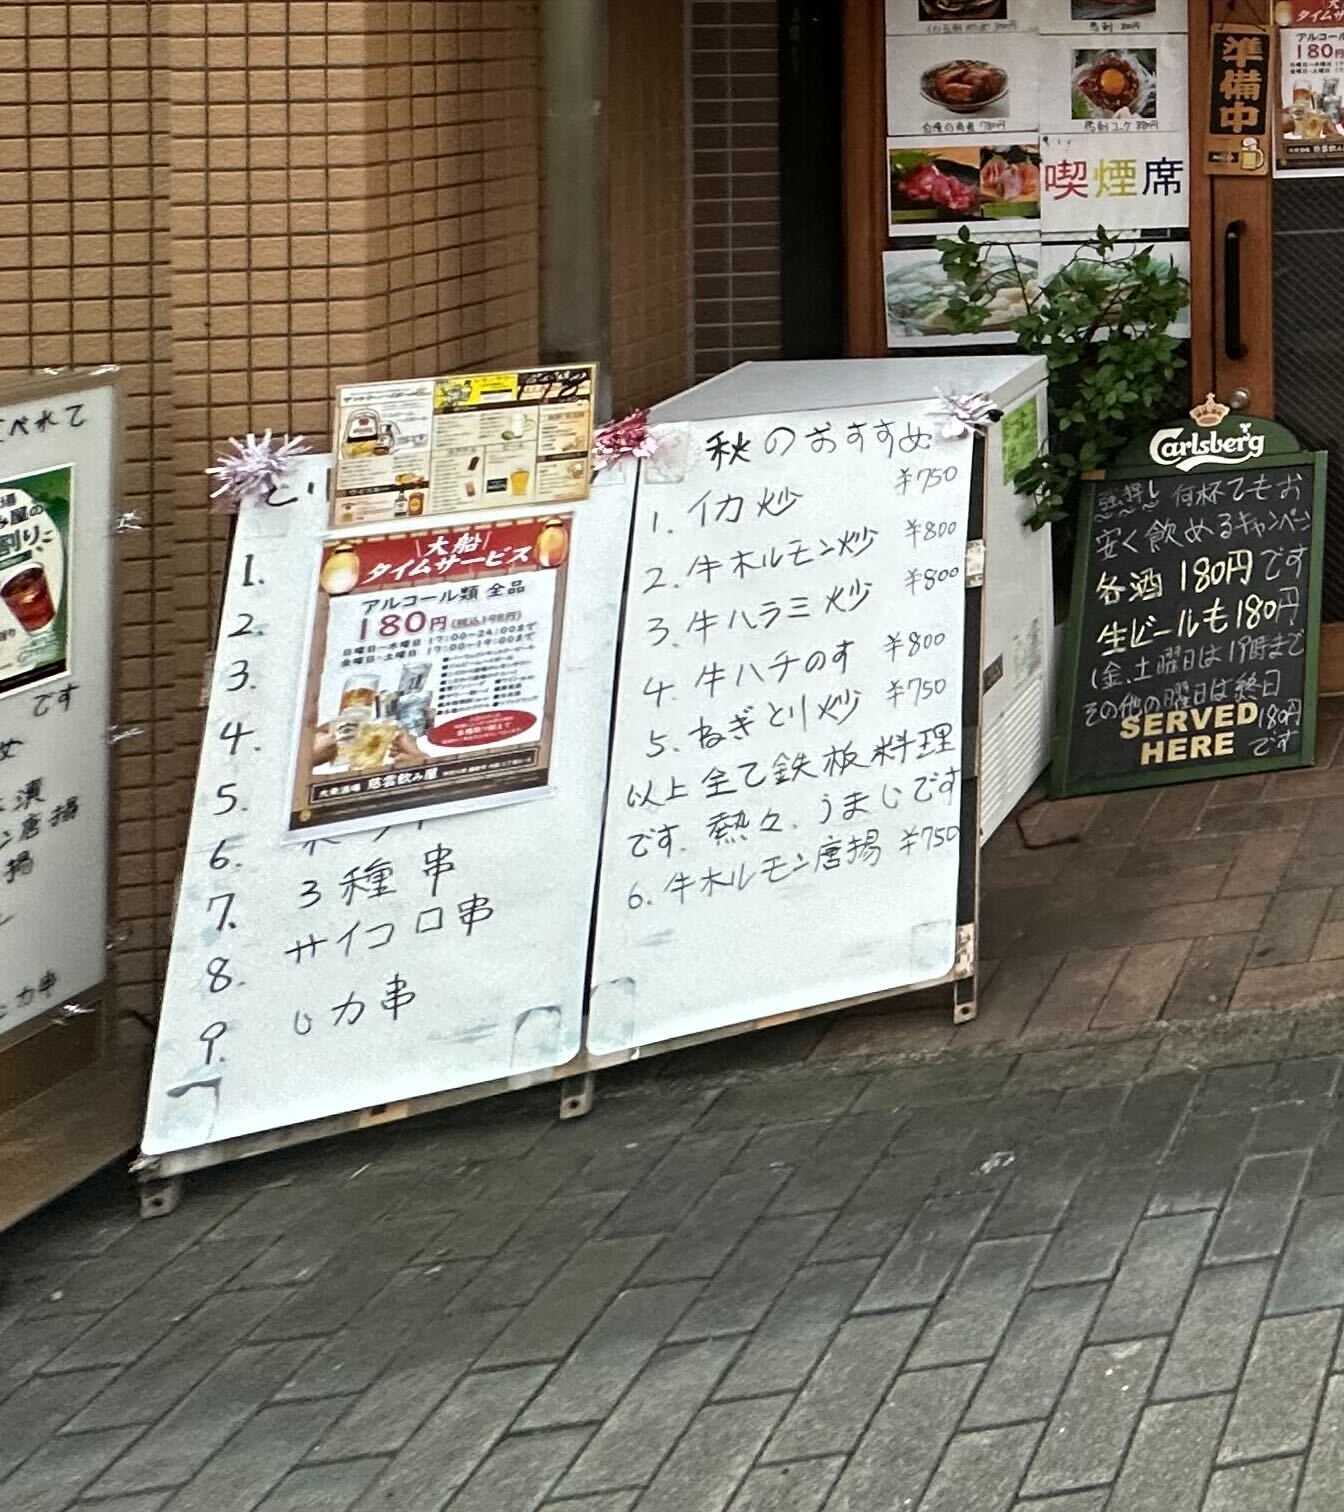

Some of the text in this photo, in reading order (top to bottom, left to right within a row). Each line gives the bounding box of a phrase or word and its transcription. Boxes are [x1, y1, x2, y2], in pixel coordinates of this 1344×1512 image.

[1220, 37, 1262, 134] 準備中
[1045, 156, 1184, 200] 喫煙席
[706, 419, 934, 471] 秋のおすすめ
[1150, 423, 1265, 466] Carlsberg
[688, 486, 803, 527] イカ炒
[895, 466, 957, 495] ¥750
[425, 532, 482, 556] 大船
[905, 519, 957, 549] ¥800
[361, 545, 533, 584] タイムサービス
[1096, 545, 1308, 606] 各酒 180円です
[361, 580, 526, 615] アルコール類 全品
[686, 578, 873, 645] 牛ハラミ炒
[905, 567, 959, 596] ¥800
[359, 610, 448, 641] 180円
[1097, 587, 1299, 656] 生ビールも180円
[695, 639, 855, 698] 牛ハチのす
[885, 632, 946, 663] ¥800
[886, 677, 947, 707] ¥750
[1120, 702, 1258, 738] SERVED
[1258, 698, 1302, 729] 180円
[1140, 731, 1235, 765] HERE
[1248, 729, 1299, 757] です
[627, 723, 956, 807] 以上全て鉄板料理
[899, 826, 960, 856] ¥750
[285, 892, 494, 964] サイコロ串
